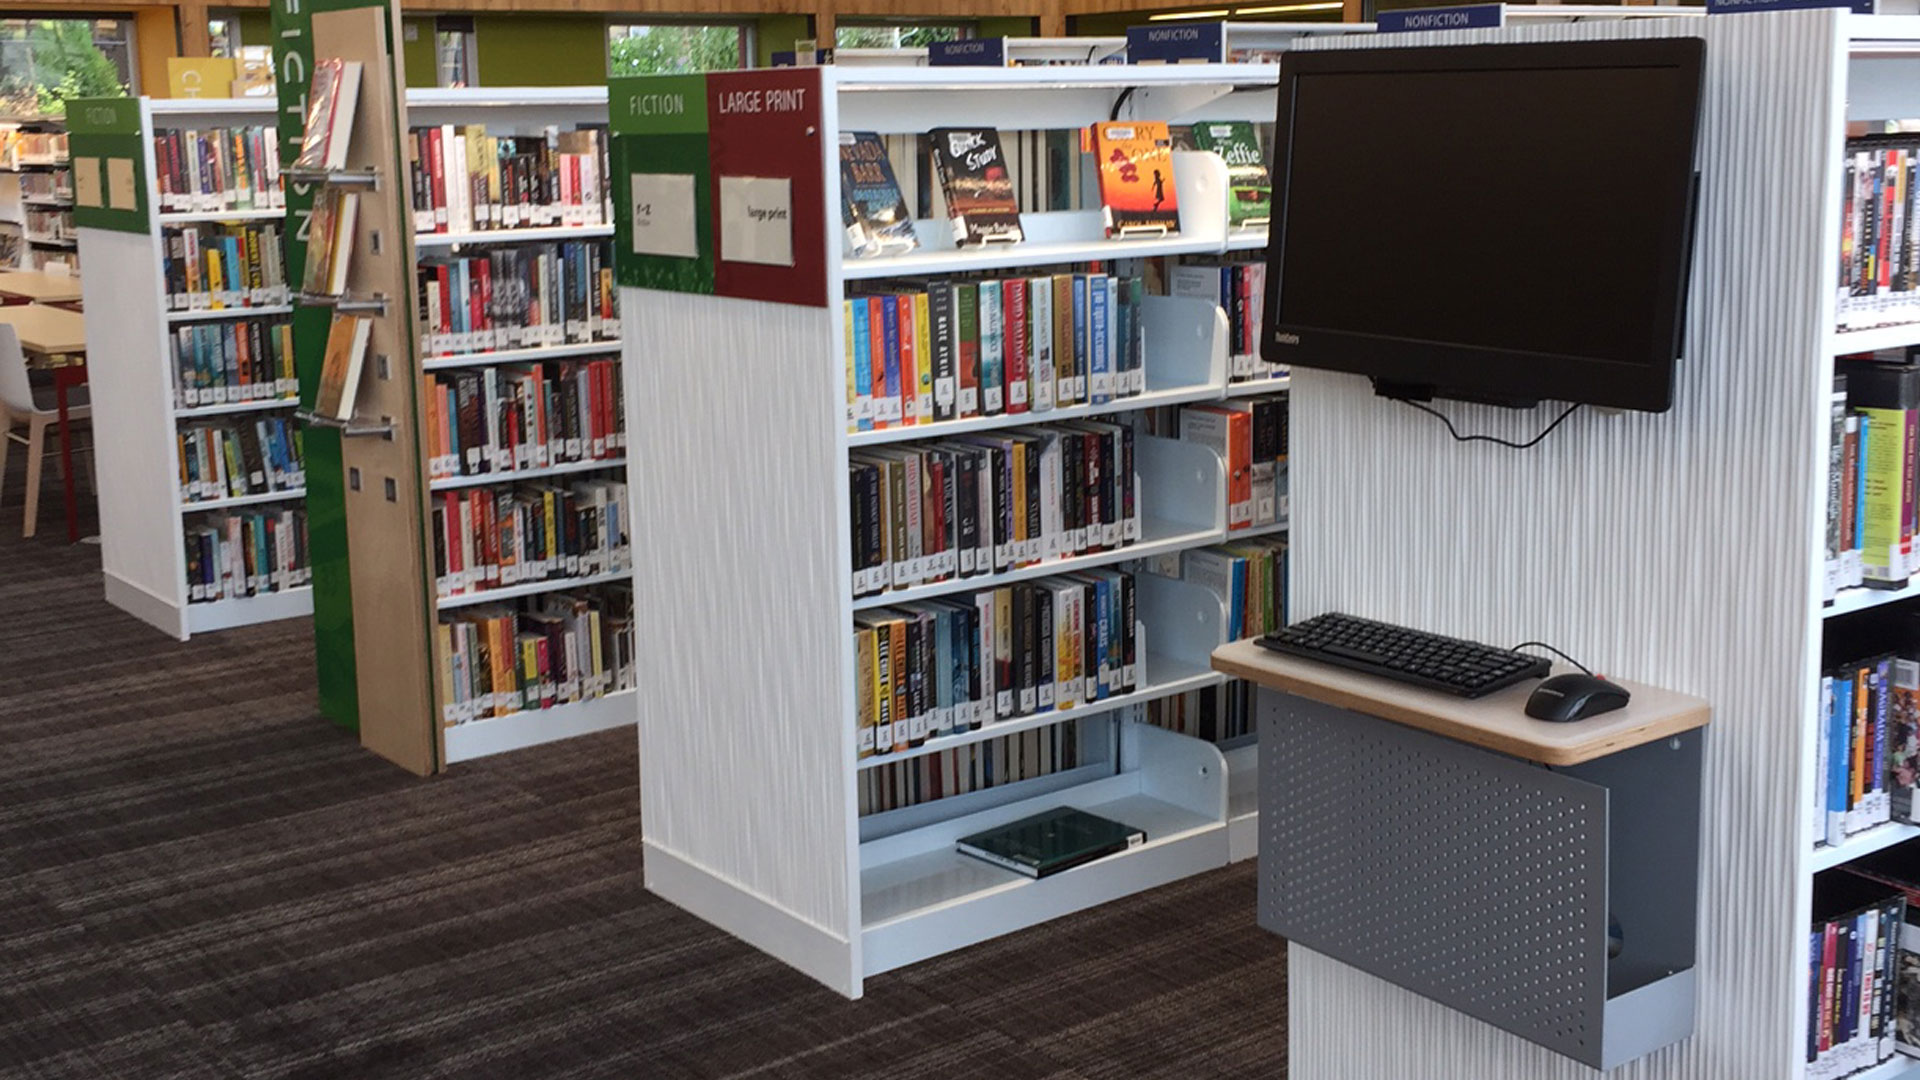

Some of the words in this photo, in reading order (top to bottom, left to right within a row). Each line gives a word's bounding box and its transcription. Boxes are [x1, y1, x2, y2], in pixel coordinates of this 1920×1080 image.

[1405, 12, 1469, 28] NONFICTION
[1148, 28, 1199, 42] NONFICTION
[944, 42, 985, 55] NONFICTION
[630, 94, 684, 115] FICTION
[718, 91, 762, 114] LARGE
[765, 88, 806, 112] PRINT
[1102, 126, 1155, 141] CRY
[966, 145, 998, 172] STUDY
[1010, 284, 1024, 317] DAVID
[937, 316, 948, 342] KATE
[1012, 320, 1026, 373] BALDACCI
[939, 346, 949, 378] ATKIN
[1098, 618, 1108, 648] CRAIS
[879, 639, 889, 657] LEE
[879, 658, 890, 683] CHILD
